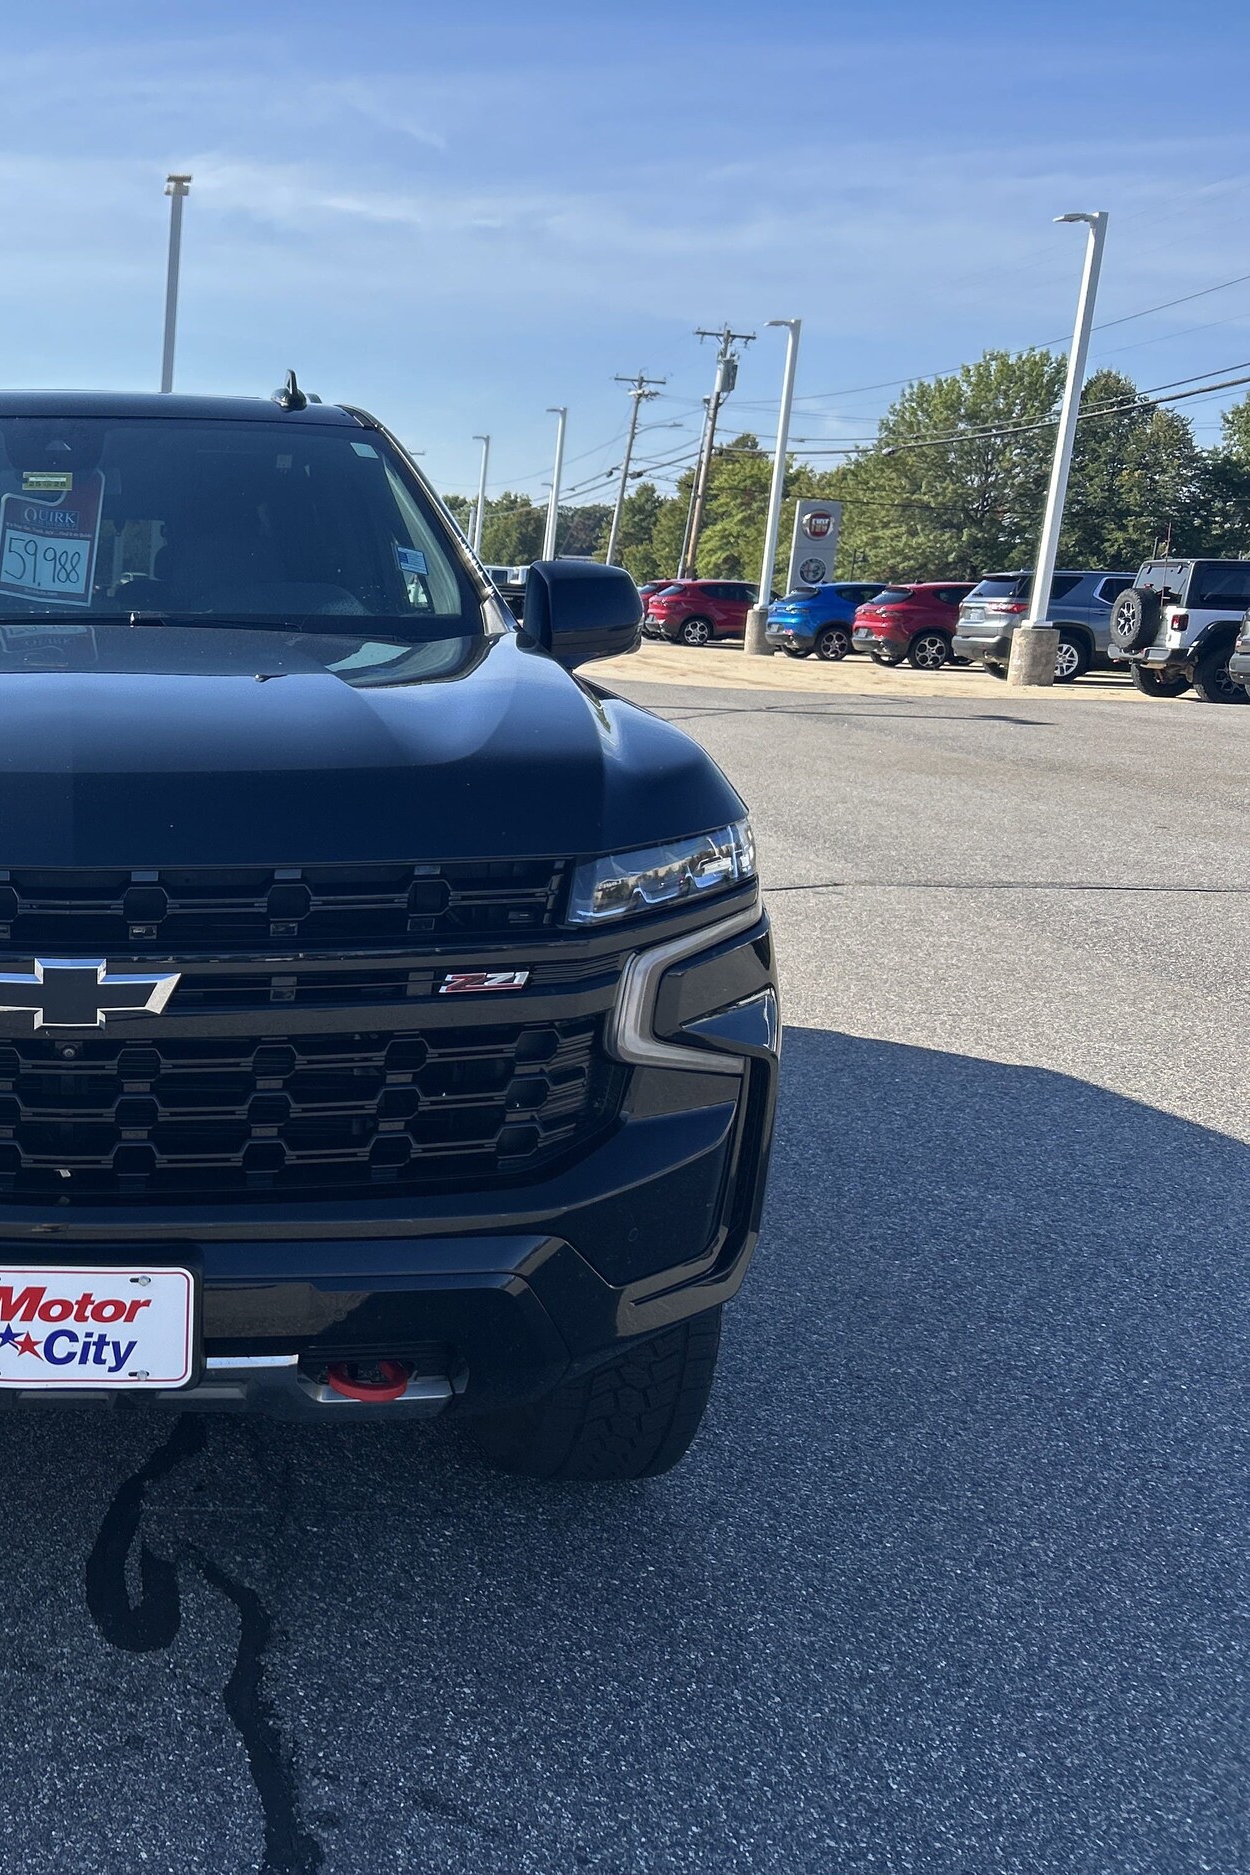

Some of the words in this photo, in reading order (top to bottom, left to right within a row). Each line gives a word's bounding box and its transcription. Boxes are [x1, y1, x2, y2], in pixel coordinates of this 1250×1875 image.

[24, 507, 76, 523] QUIRK
[439, 972, 529, 993] Z71
[43, 1329, 138, 1372] City
